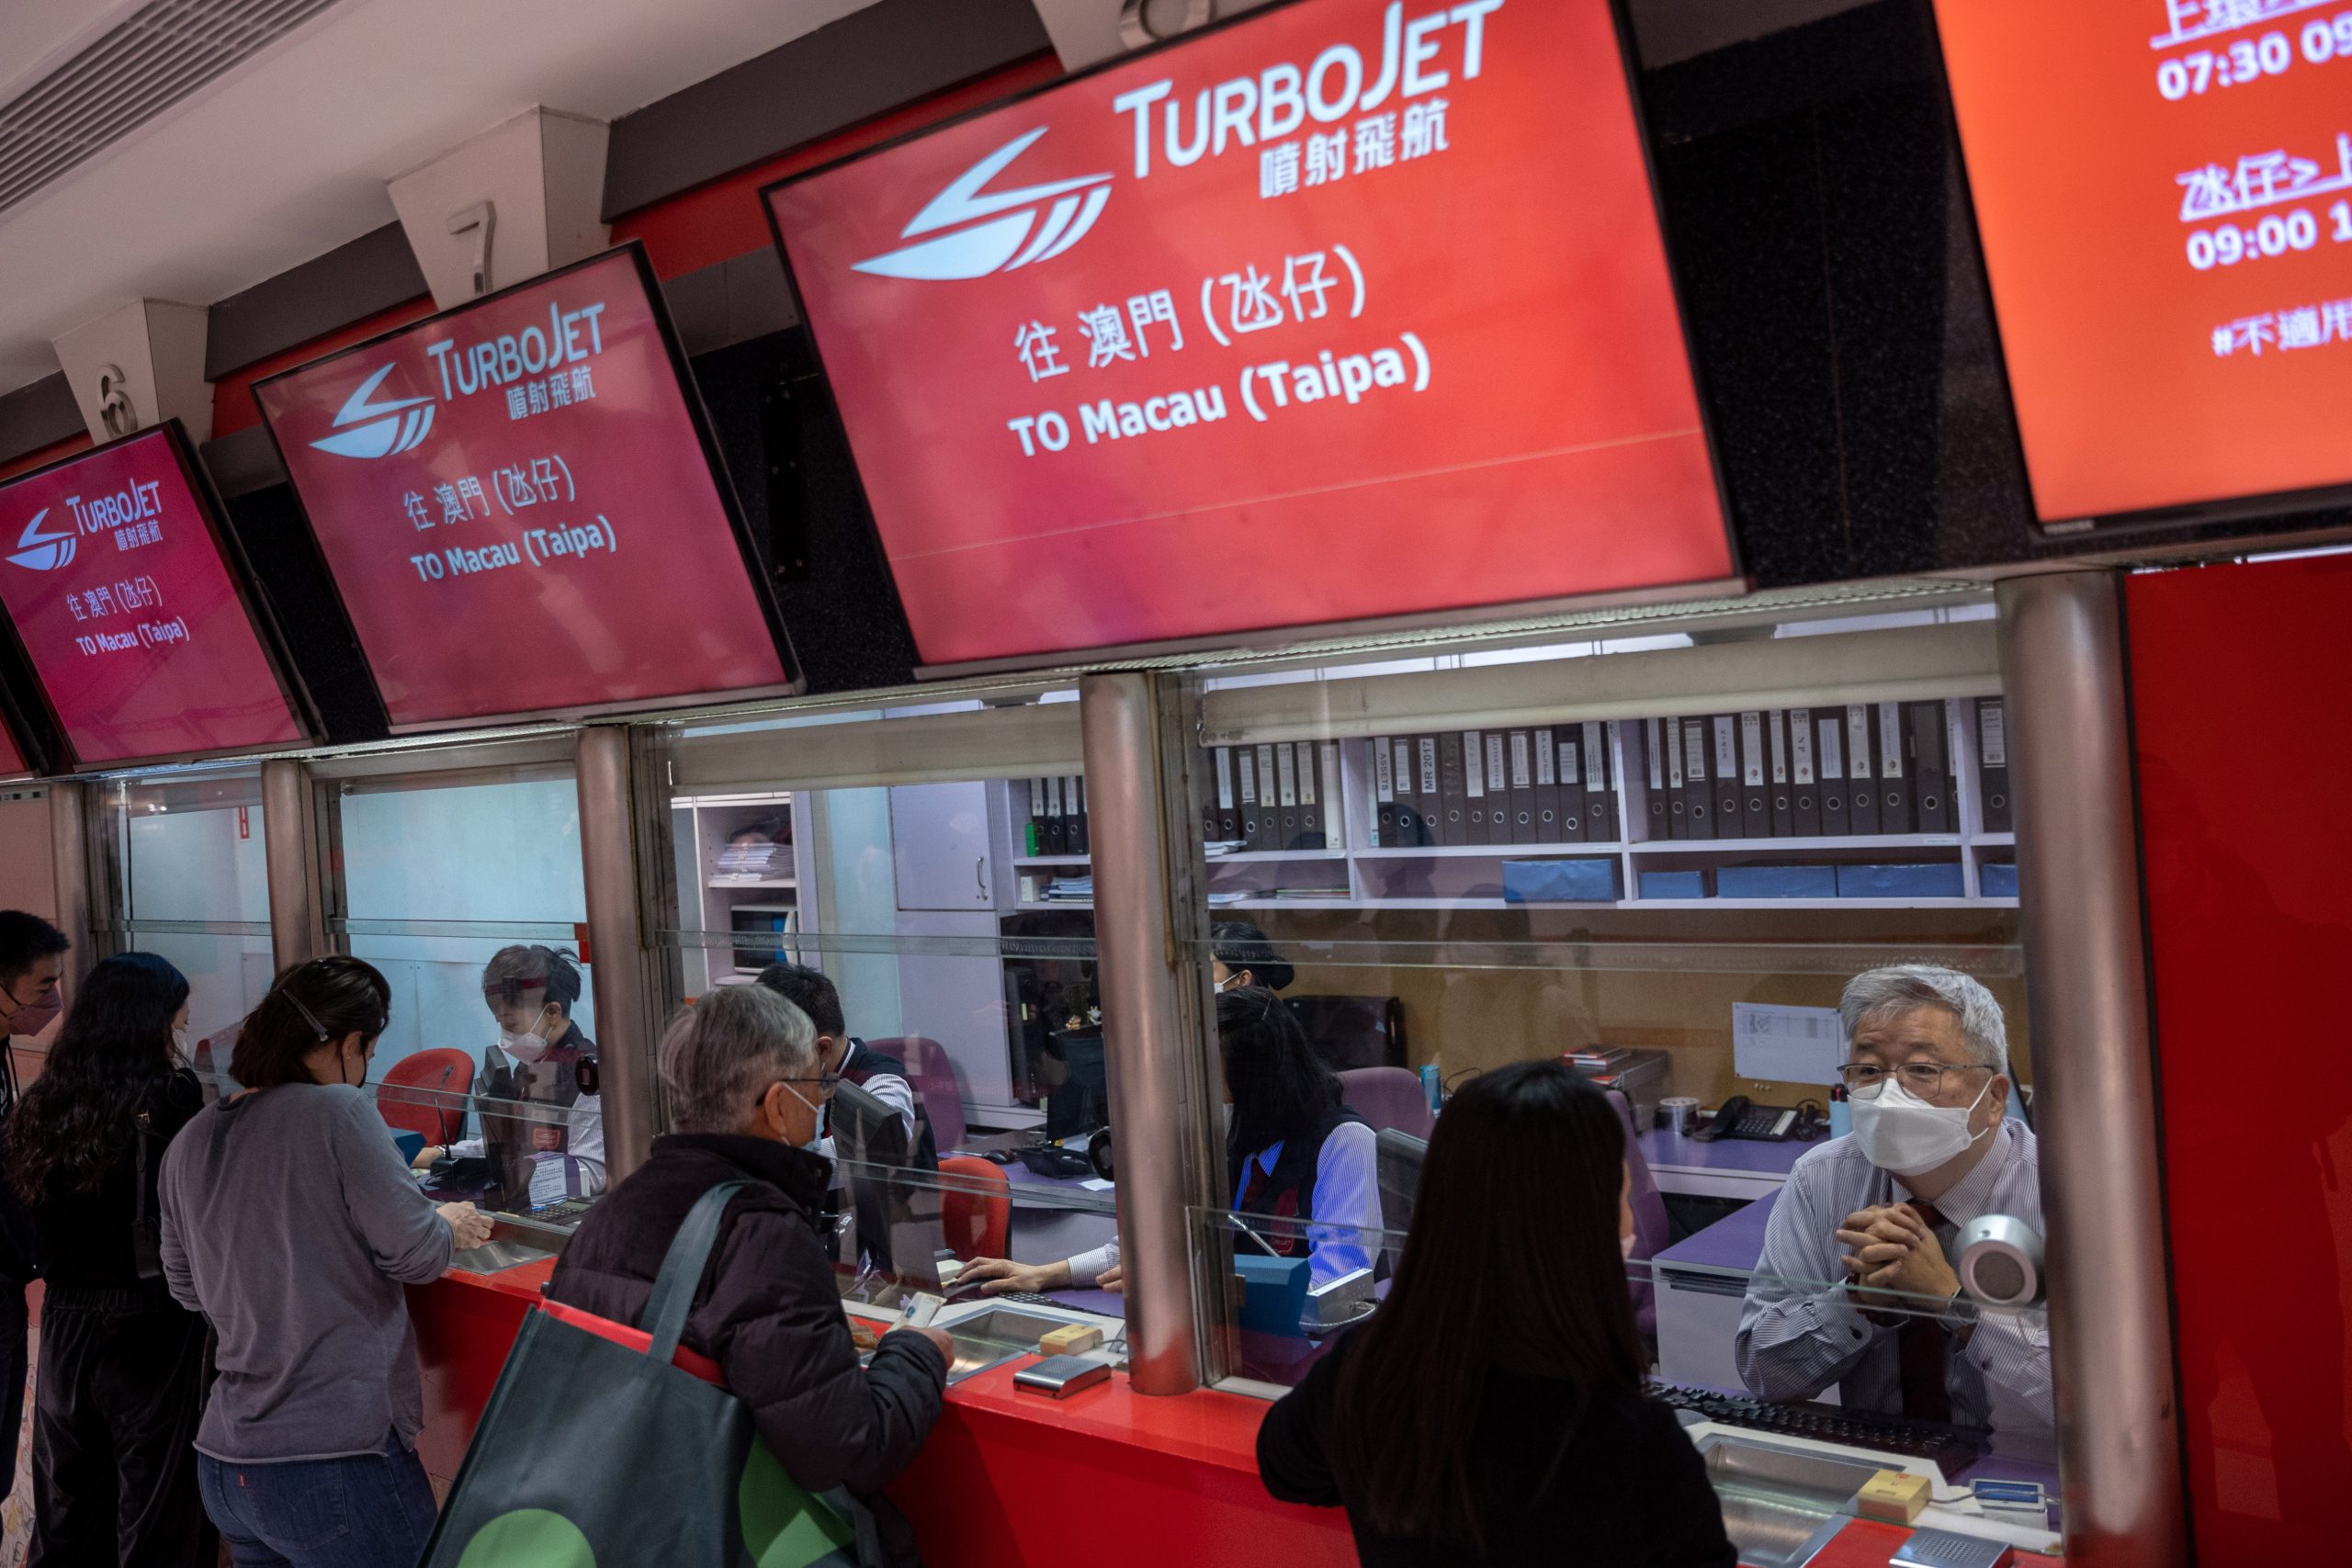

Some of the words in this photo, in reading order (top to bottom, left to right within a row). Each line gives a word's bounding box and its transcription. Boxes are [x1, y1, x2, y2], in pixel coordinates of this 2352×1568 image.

[2157, 32, 2290, 100] 07:30
[1260, 98, 1449, 199] 噴射飛航
[447, 200, 496, 295] 7
[2187, 209, 2317, 270] 09:00
[96, 364, 138, 438] 6
[506, 364, 597, 421] 噴射飛航
[1007, 411, 1070, 457] TO
[1079, 385, 1227, 444] Macau
[1239, 332, 1430, 422] (Taipa)
[411, 552, 444, 581] TO
[445, 542, 522, 575] Macau
[523, 514, 616, 568] (Taipa)
[75, 635, 97, 656] TO
[95, 631, 140, 653] Macau
[137, 616, 190, 649] (Taipa)
[1423, 741, 1432, 768] 2017
[1424, 771, 1433, 790] MR
